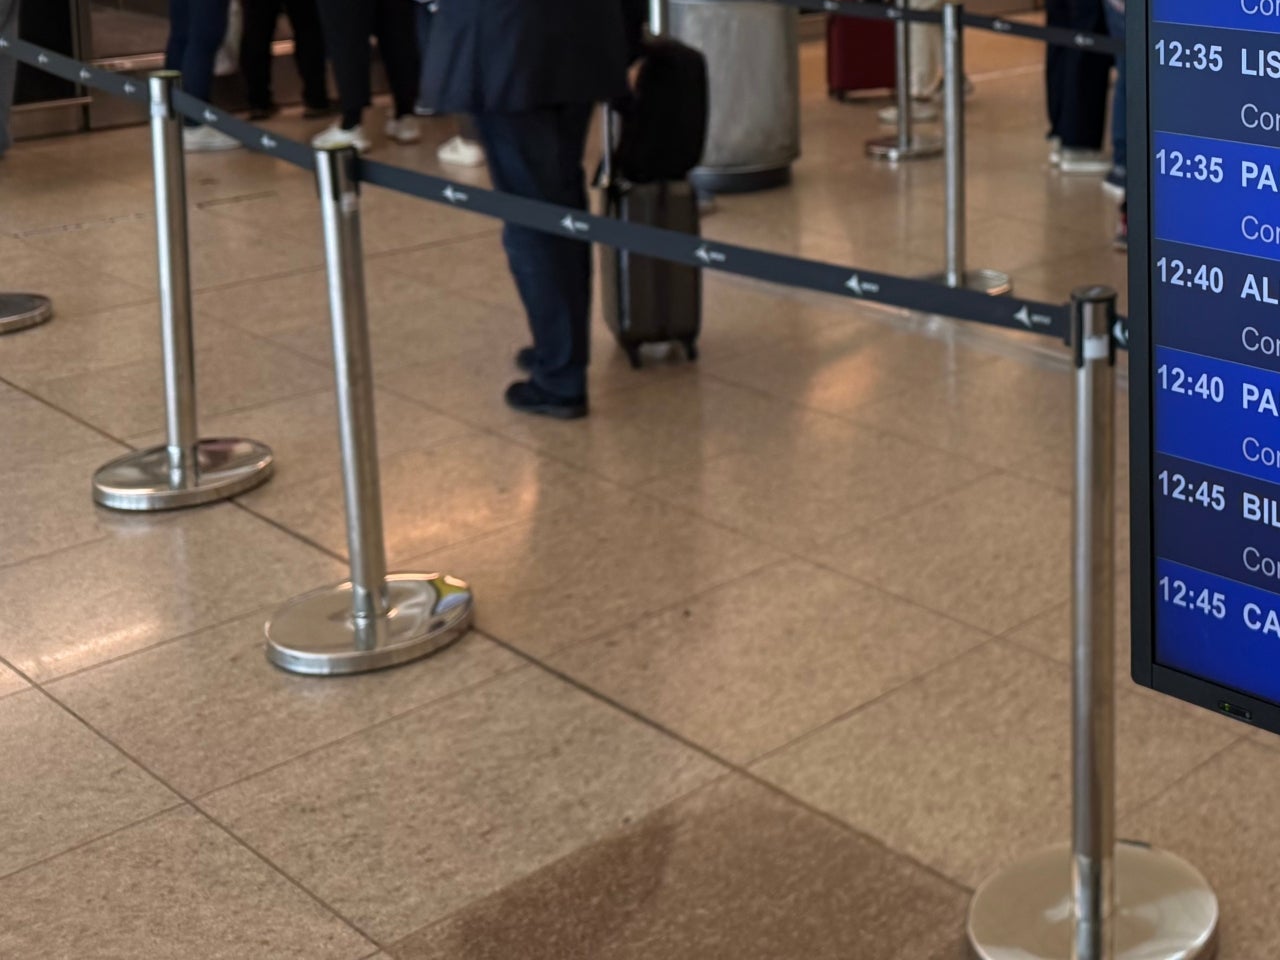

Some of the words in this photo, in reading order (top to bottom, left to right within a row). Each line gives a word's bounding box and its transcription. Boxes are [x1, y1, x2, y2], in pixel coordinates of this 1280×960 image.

[1155, 39, 1223, 72] 12:35
[1156, 148, 1224, 183] 12:35
[1156, 256, 1224, 294] 12:40
[1158, 364, 1224, 403] 12:40
[1158, 470, 1225, 511] 12:45
[1160, 576, 1226, 618] 12:45
